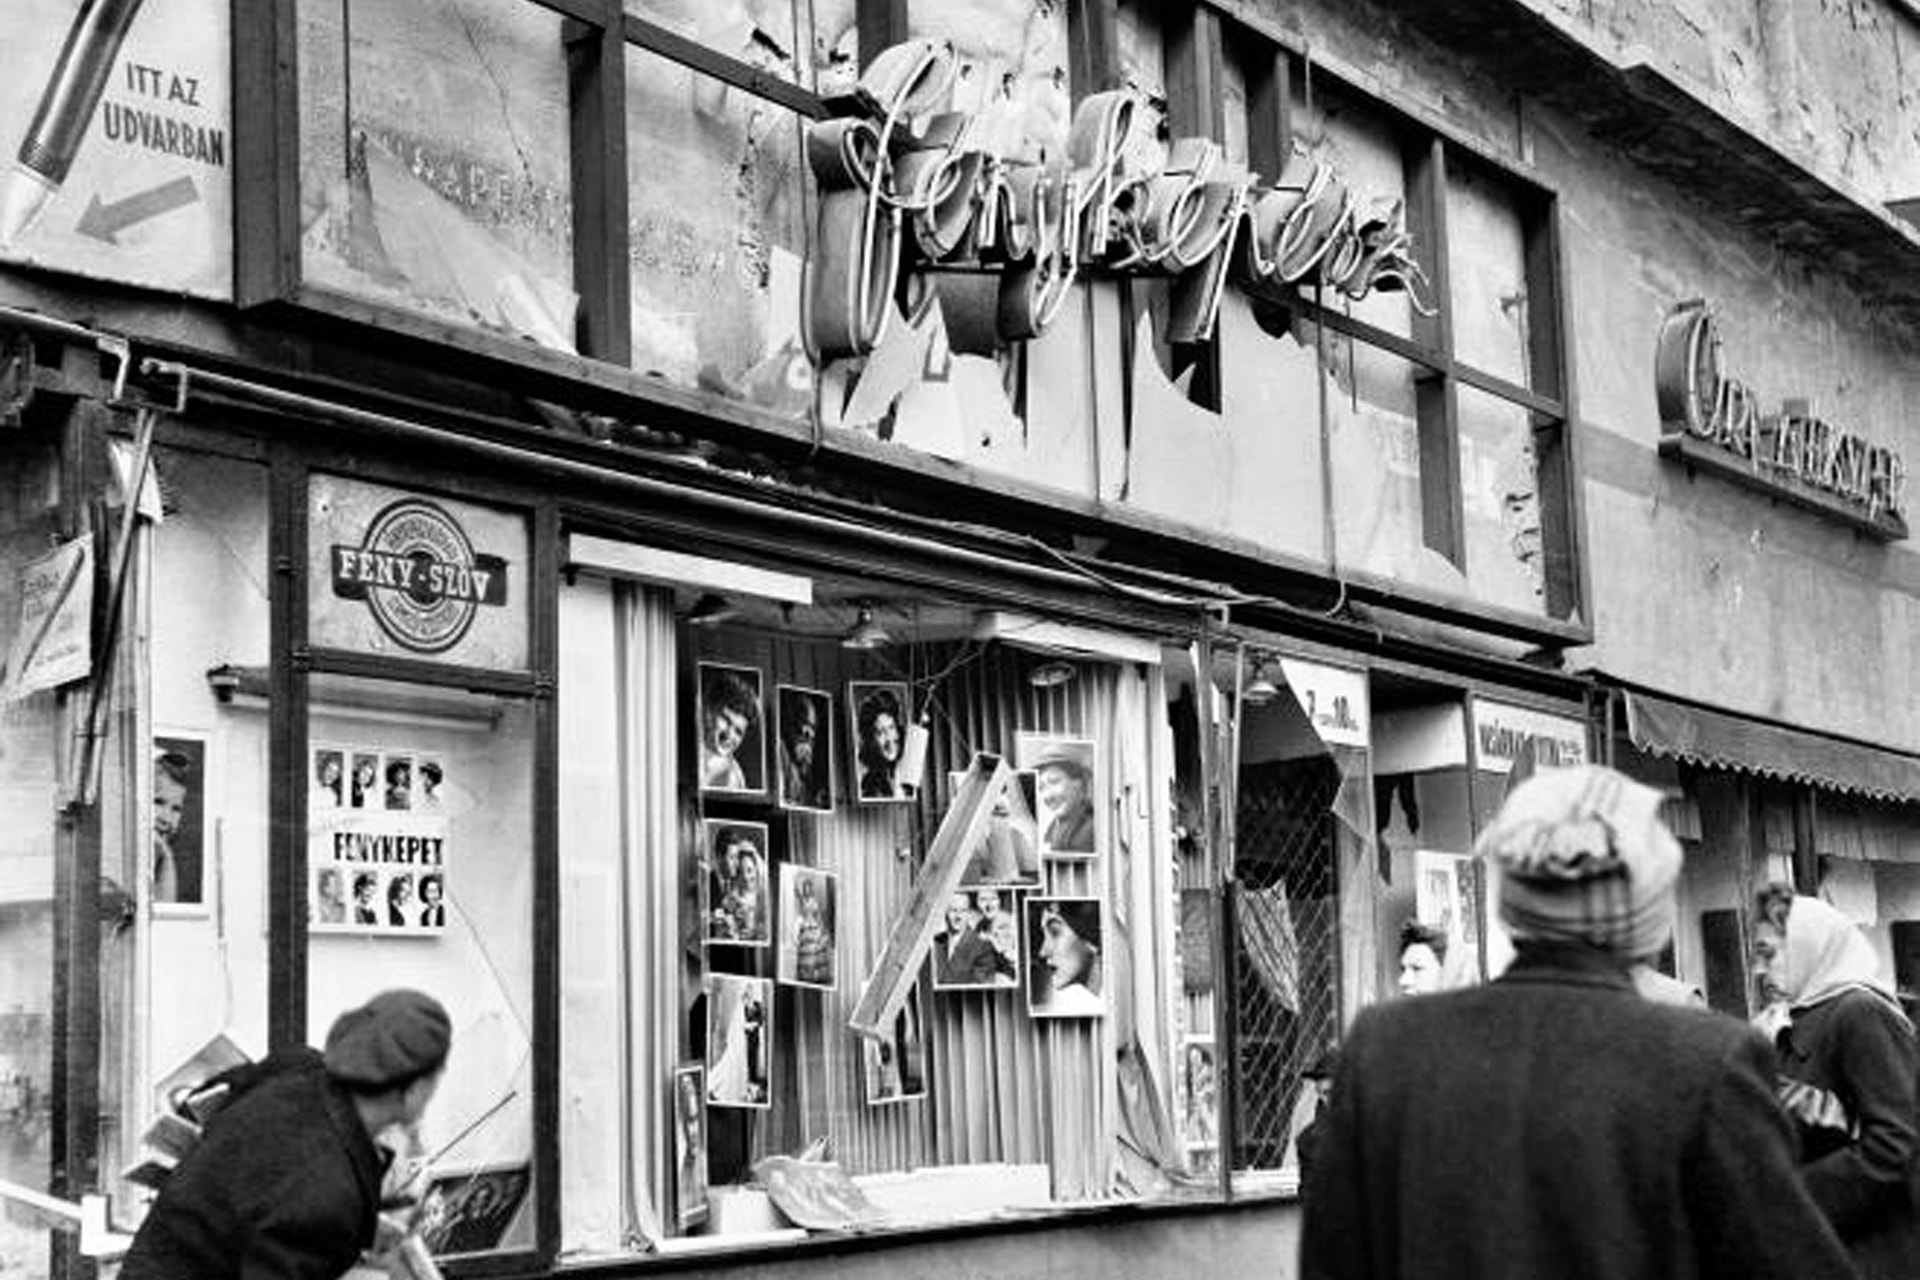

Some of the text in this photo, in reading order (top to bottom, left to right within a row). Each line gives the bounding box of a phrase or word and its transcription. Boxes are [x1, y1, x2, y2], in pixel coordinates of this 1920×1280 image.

[127, 61, 199, 106] ITT AZ
[104, 101, 224, 168] UDVARBAN
